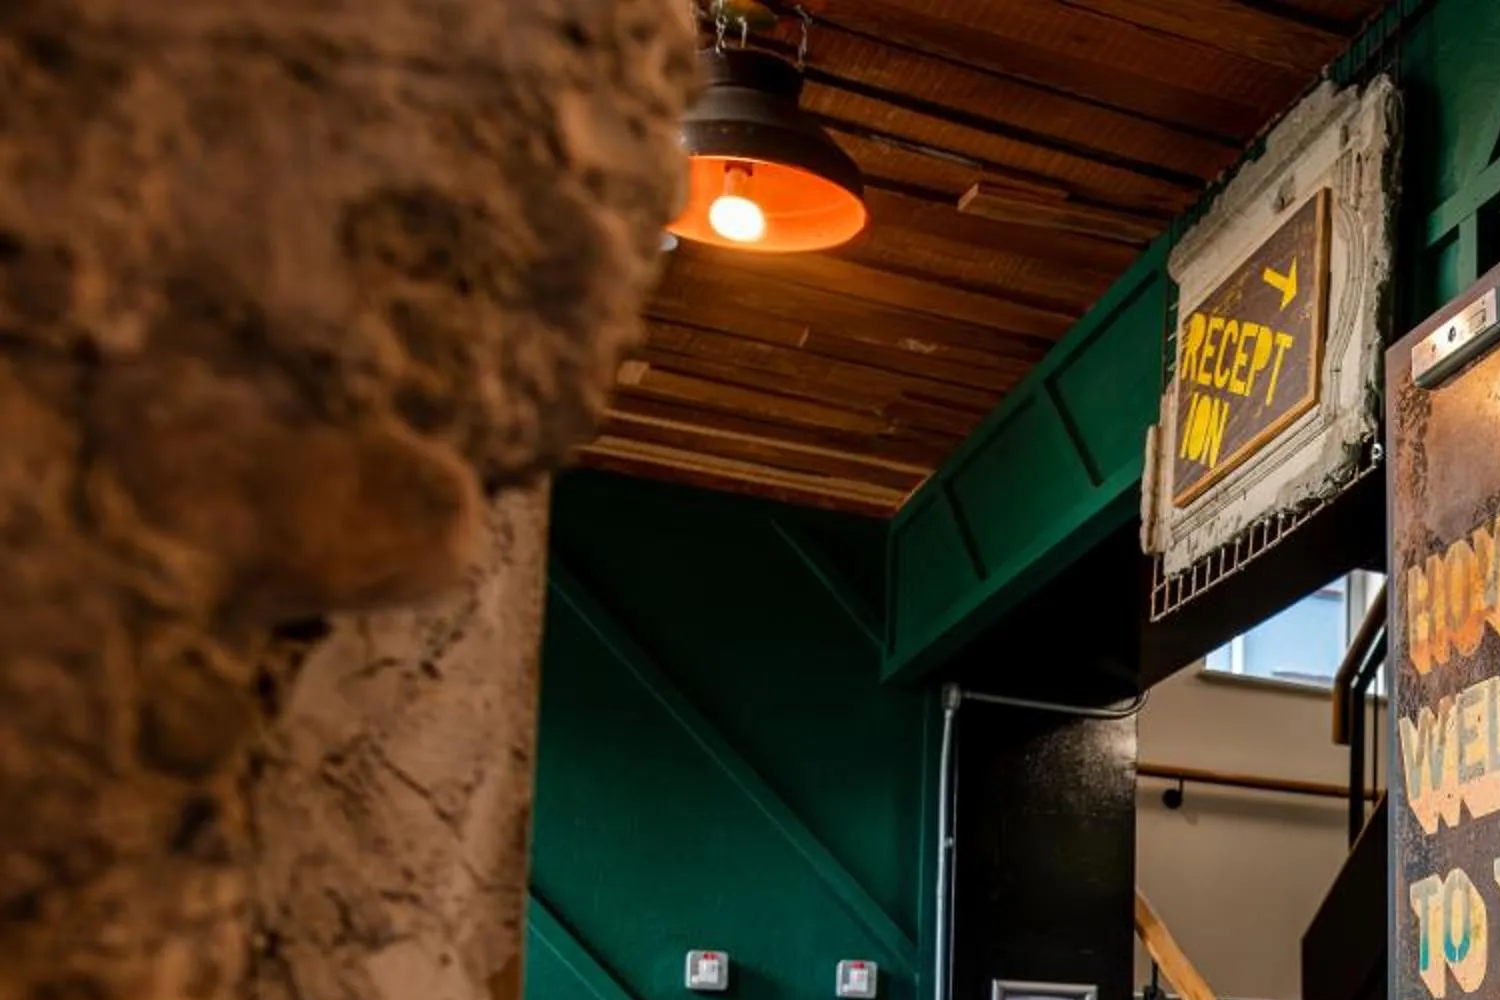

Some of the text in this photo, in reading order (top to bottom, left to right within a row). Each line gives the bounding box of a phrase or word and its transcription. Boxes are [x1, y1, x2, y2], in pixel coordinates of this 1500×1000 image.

[1181, 311, 1293, 406] RECEPT
[1180, 391, 1230, 468] ION
[1410, 868, 1487, 998] TO
